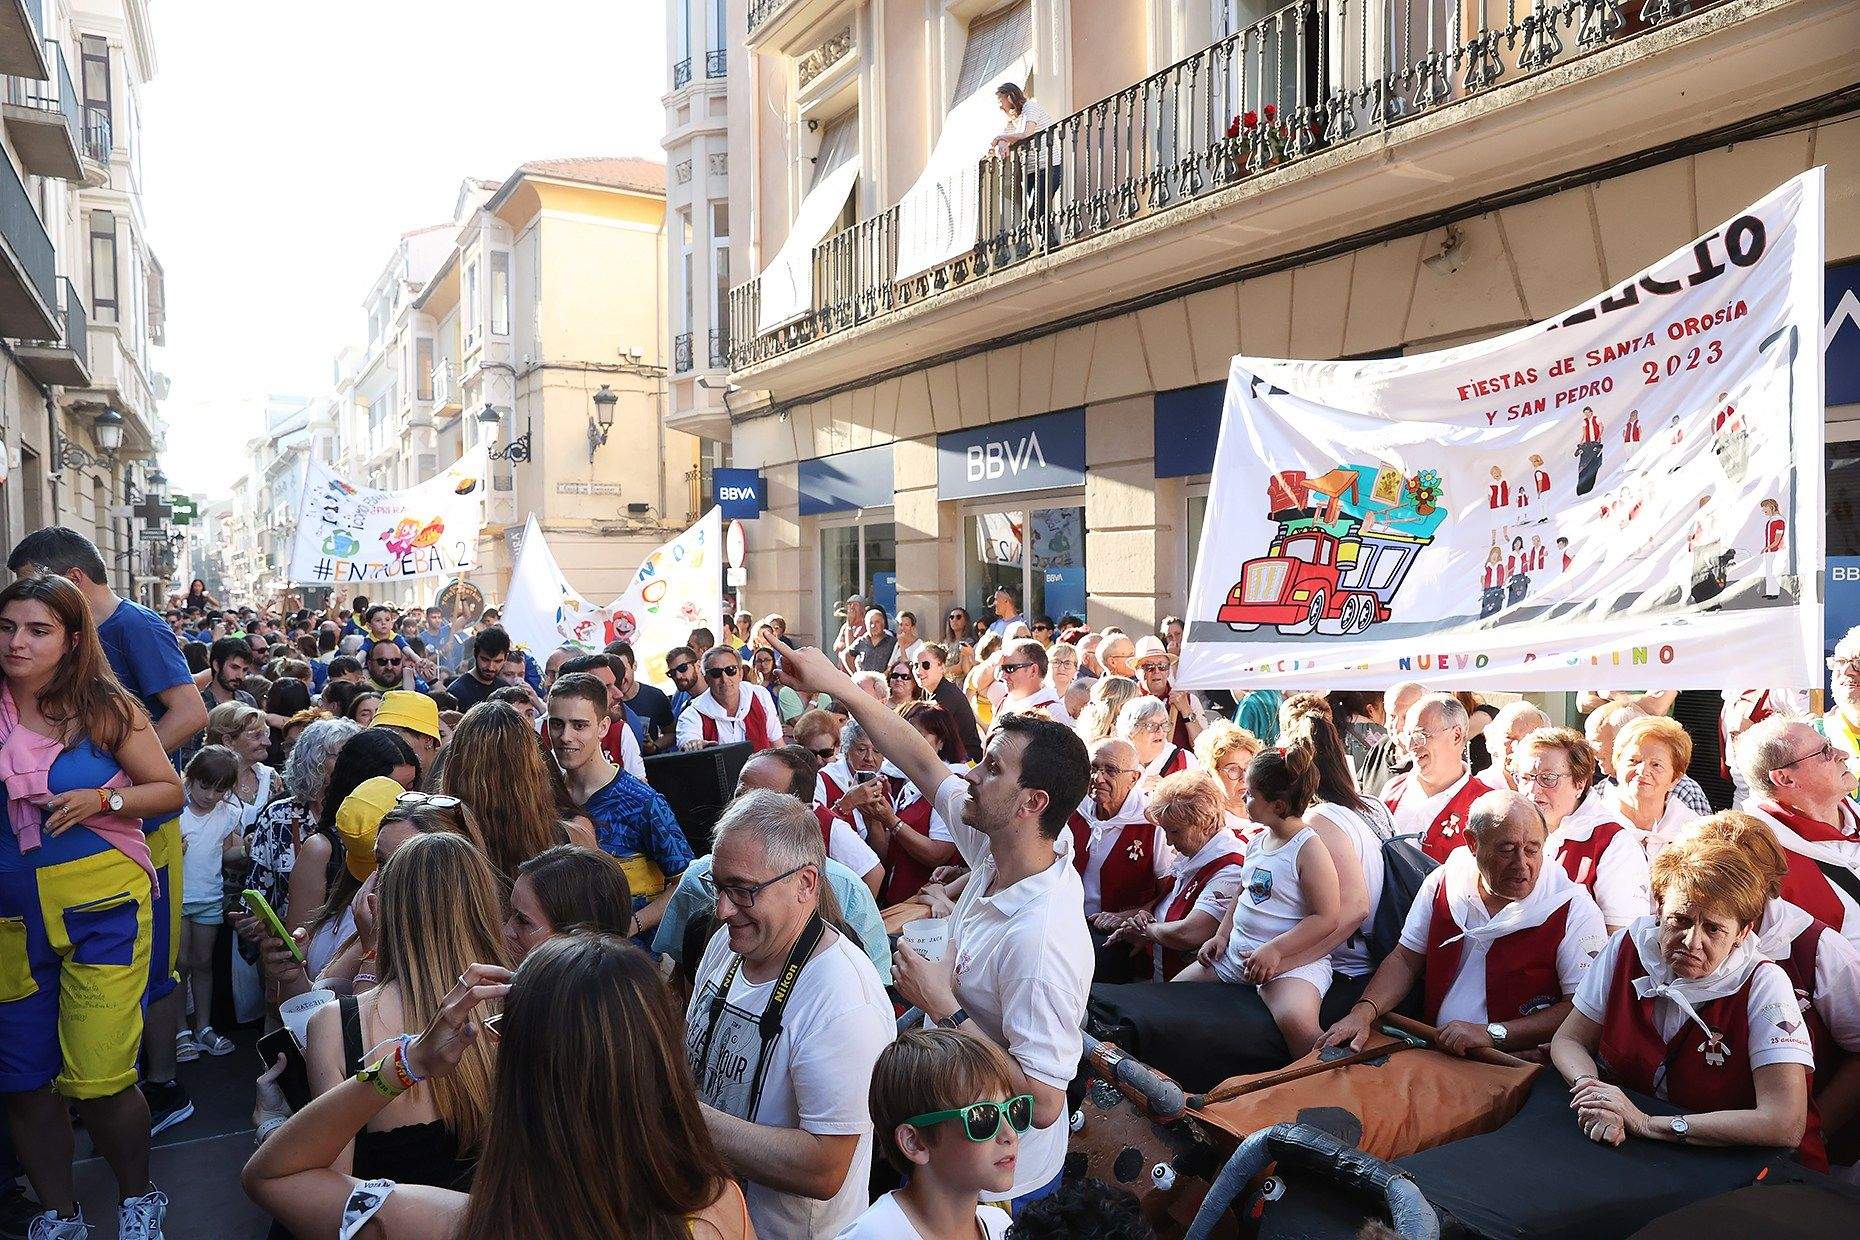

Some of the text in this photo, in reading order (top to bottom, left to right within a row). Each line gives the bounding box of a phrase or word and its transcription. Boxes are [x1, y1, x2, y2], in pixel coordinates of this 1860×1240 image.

[1586, 332, 1656, 367] SANTA
[1486, 340, 1723, 425] Y SAN PEDRO 2023
[966, 430, 1047, 483] BBVA
[719, 486, 755, 500] BBVA
[1046, 573, 1063, 582] BBVA
[1399, 654, 1489, 671] NUEVO
[774, 964, 798, 1003] Nikon
